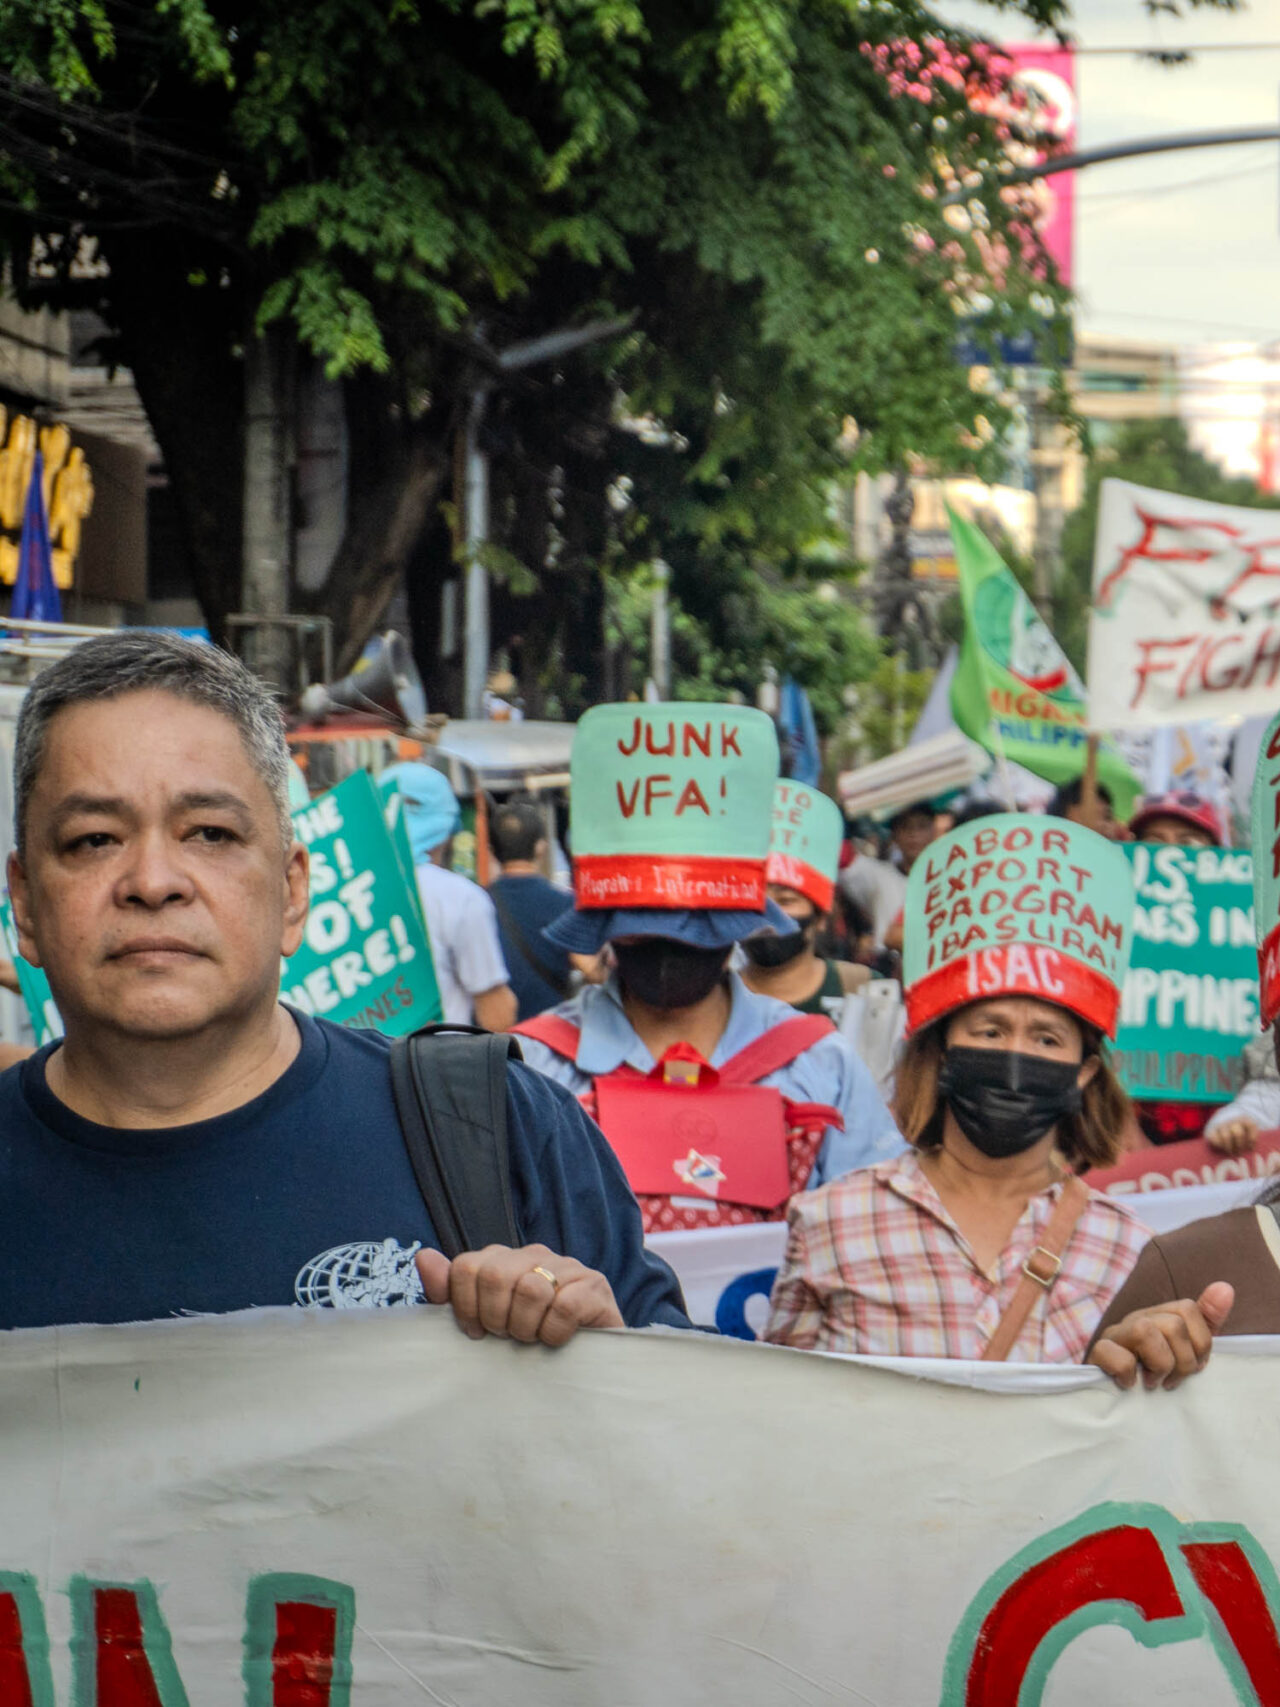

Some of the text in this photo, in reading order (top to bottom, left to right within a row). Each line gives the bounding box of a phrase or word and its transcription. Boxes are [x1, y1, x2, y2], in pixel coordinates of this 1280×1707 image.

[617, 716, 742, 757] JUNK
[291, 794, 344, 846] HE
[616, 774, 727, 819] VFA!
[309, 838, 354, 895] S!
[925, 827, 1071, 884] LABOR
[305, 869, 377, 955] OF
[924, 857, 1093, 914] EXPORT
[927, 884, 1123, 950] PROGRAM
[967, 944, 1064, 995] ISAC
